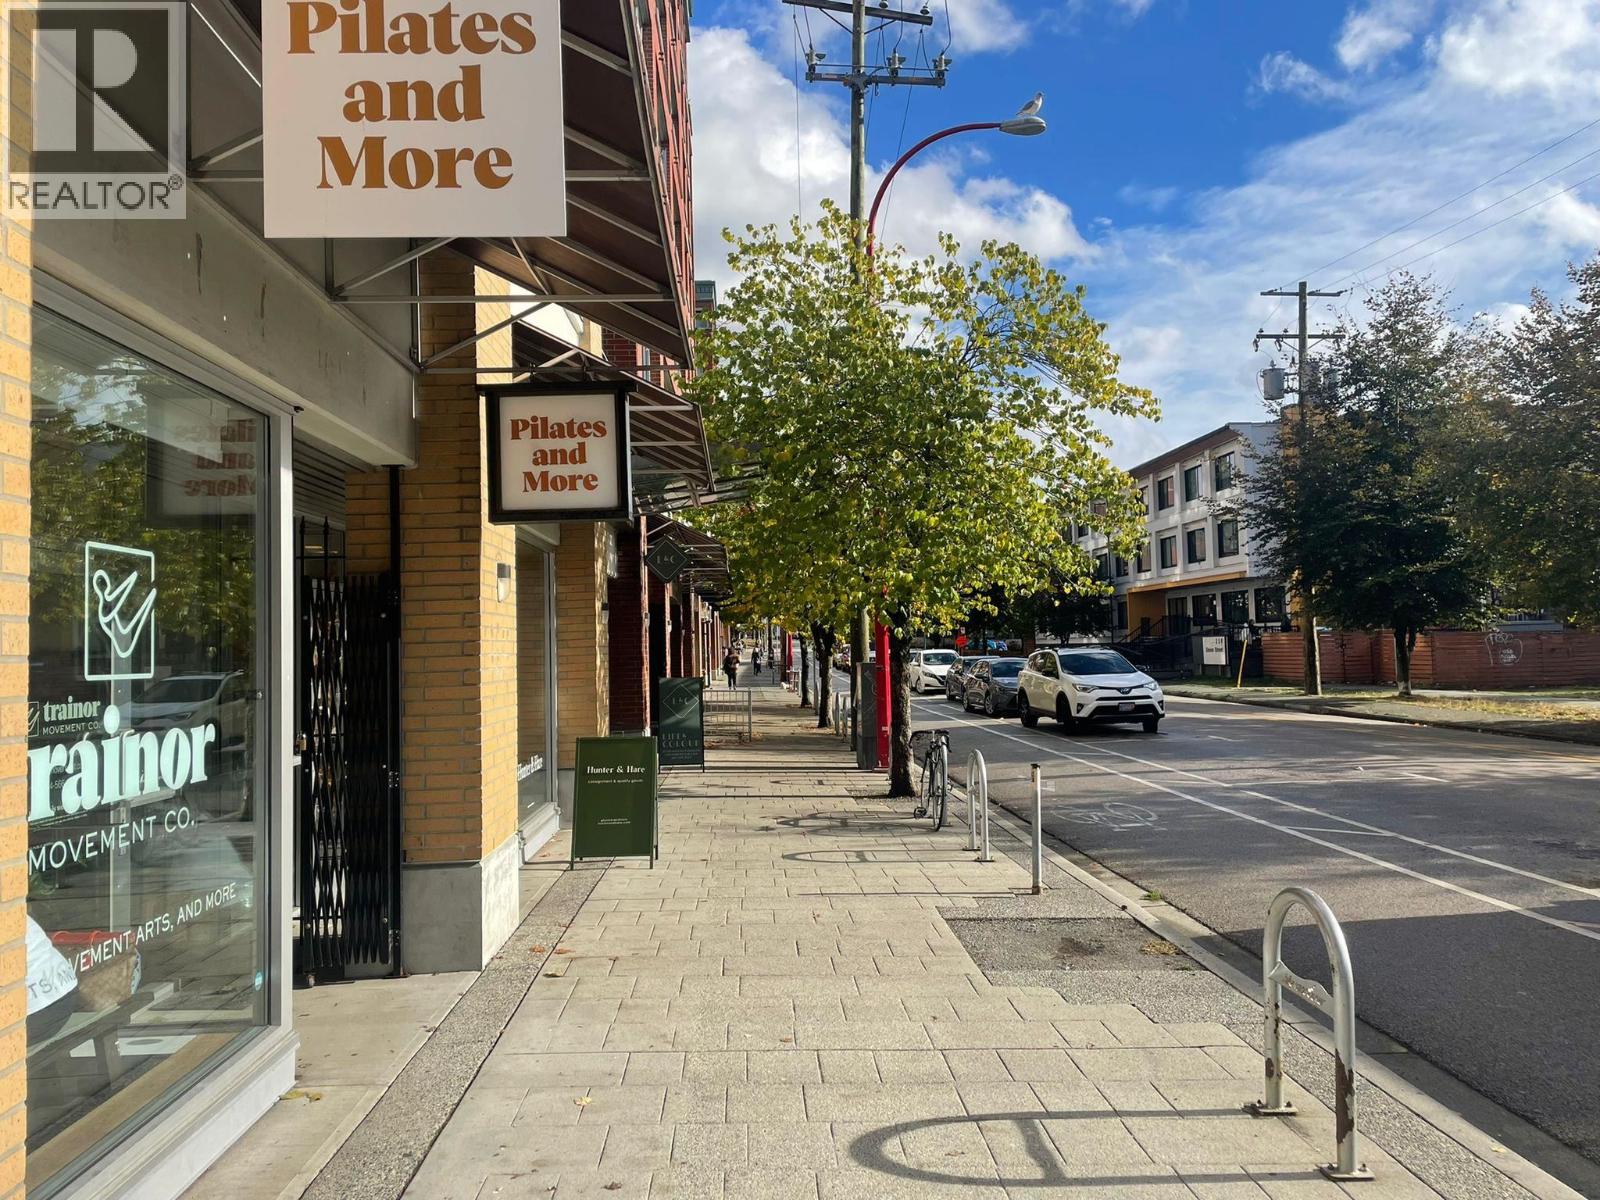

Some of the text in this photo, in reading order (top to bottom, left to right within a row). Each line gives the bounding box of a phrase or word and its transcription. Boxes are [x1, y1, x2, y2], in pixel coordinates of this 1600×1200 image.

[286, 0, 537, 55] Pilates
[342, 64, 485, 122] and
[316, 135, 514, 190] More
[510, 415, 608, 441] Pilates
[532, 442, 587, 466] and
[522, 470, 599, 493] More
[42, 721, 102, 736] MOVEMENT CO.
[43, 695, 101, 722] trainor
[28, 704, 216, 821] rainor
[586, 765, 646, 774] Hunter & Hare
[28, 806, 196, 875] MOVEMENT CO.
[69, 882, 237, 973] VEMENT ARTS, AND MORE
